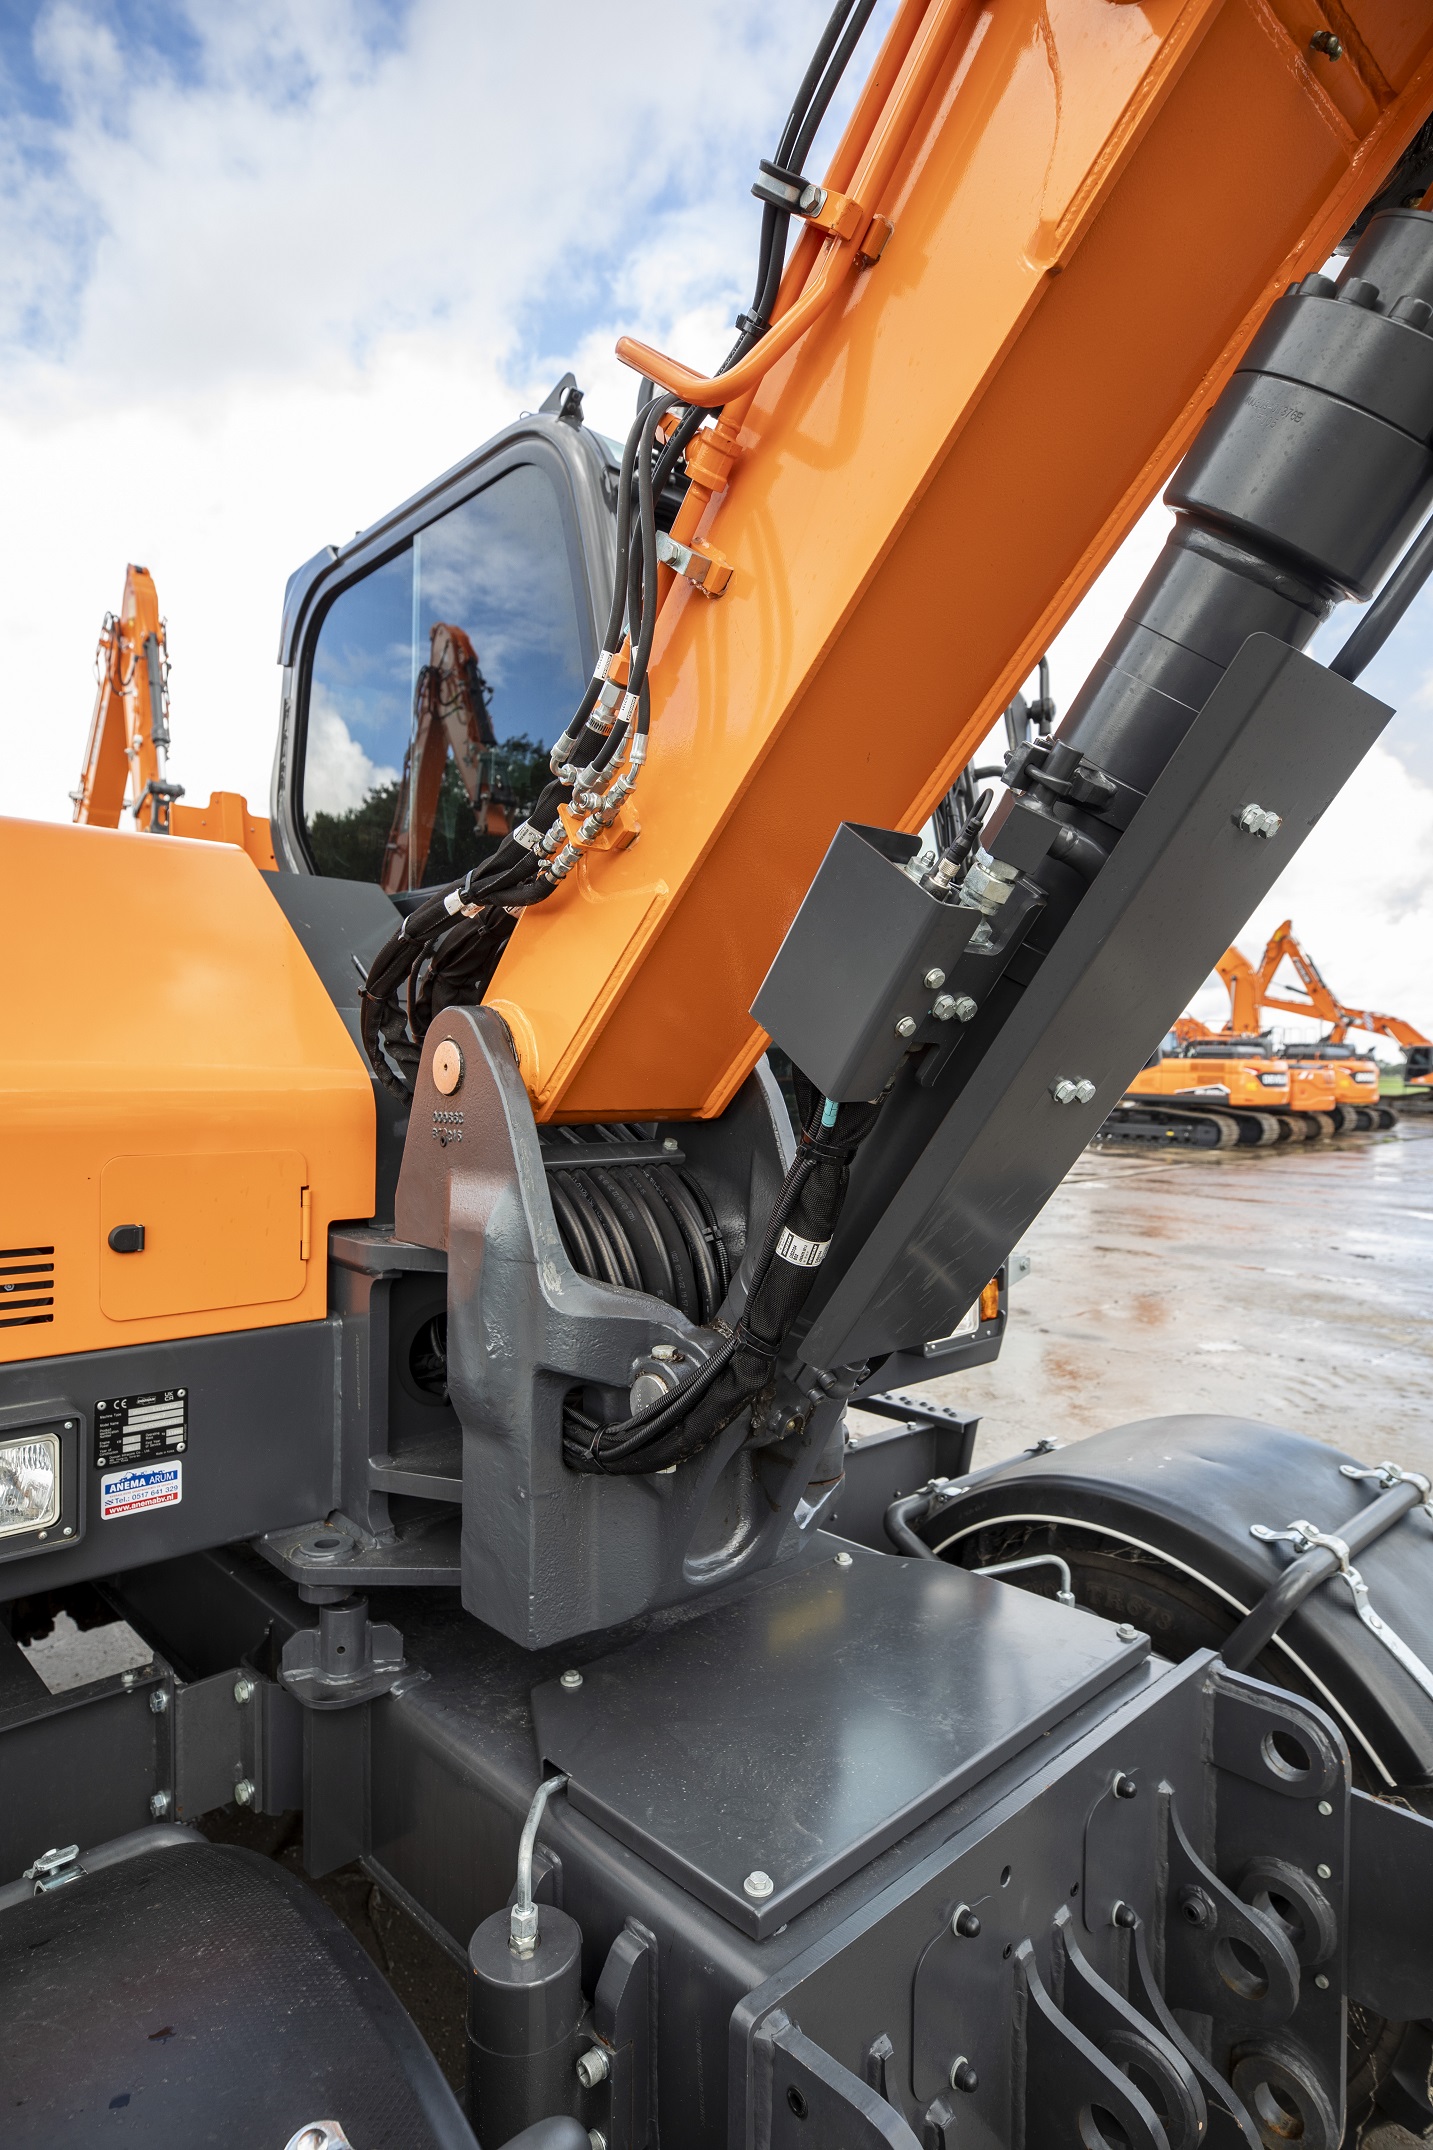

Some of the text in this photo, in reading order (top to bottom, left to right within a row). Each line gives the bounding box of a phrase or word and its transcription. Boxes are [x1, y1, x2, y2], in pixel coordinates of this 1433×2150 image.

[109, 1478, 146, 1493] ANEMA
[149, 1472, 174, 1484] ARUM
[109, 1494, 174, 1514] www.anemabv.nl
[132, 1492, 148, 1500] 0517
